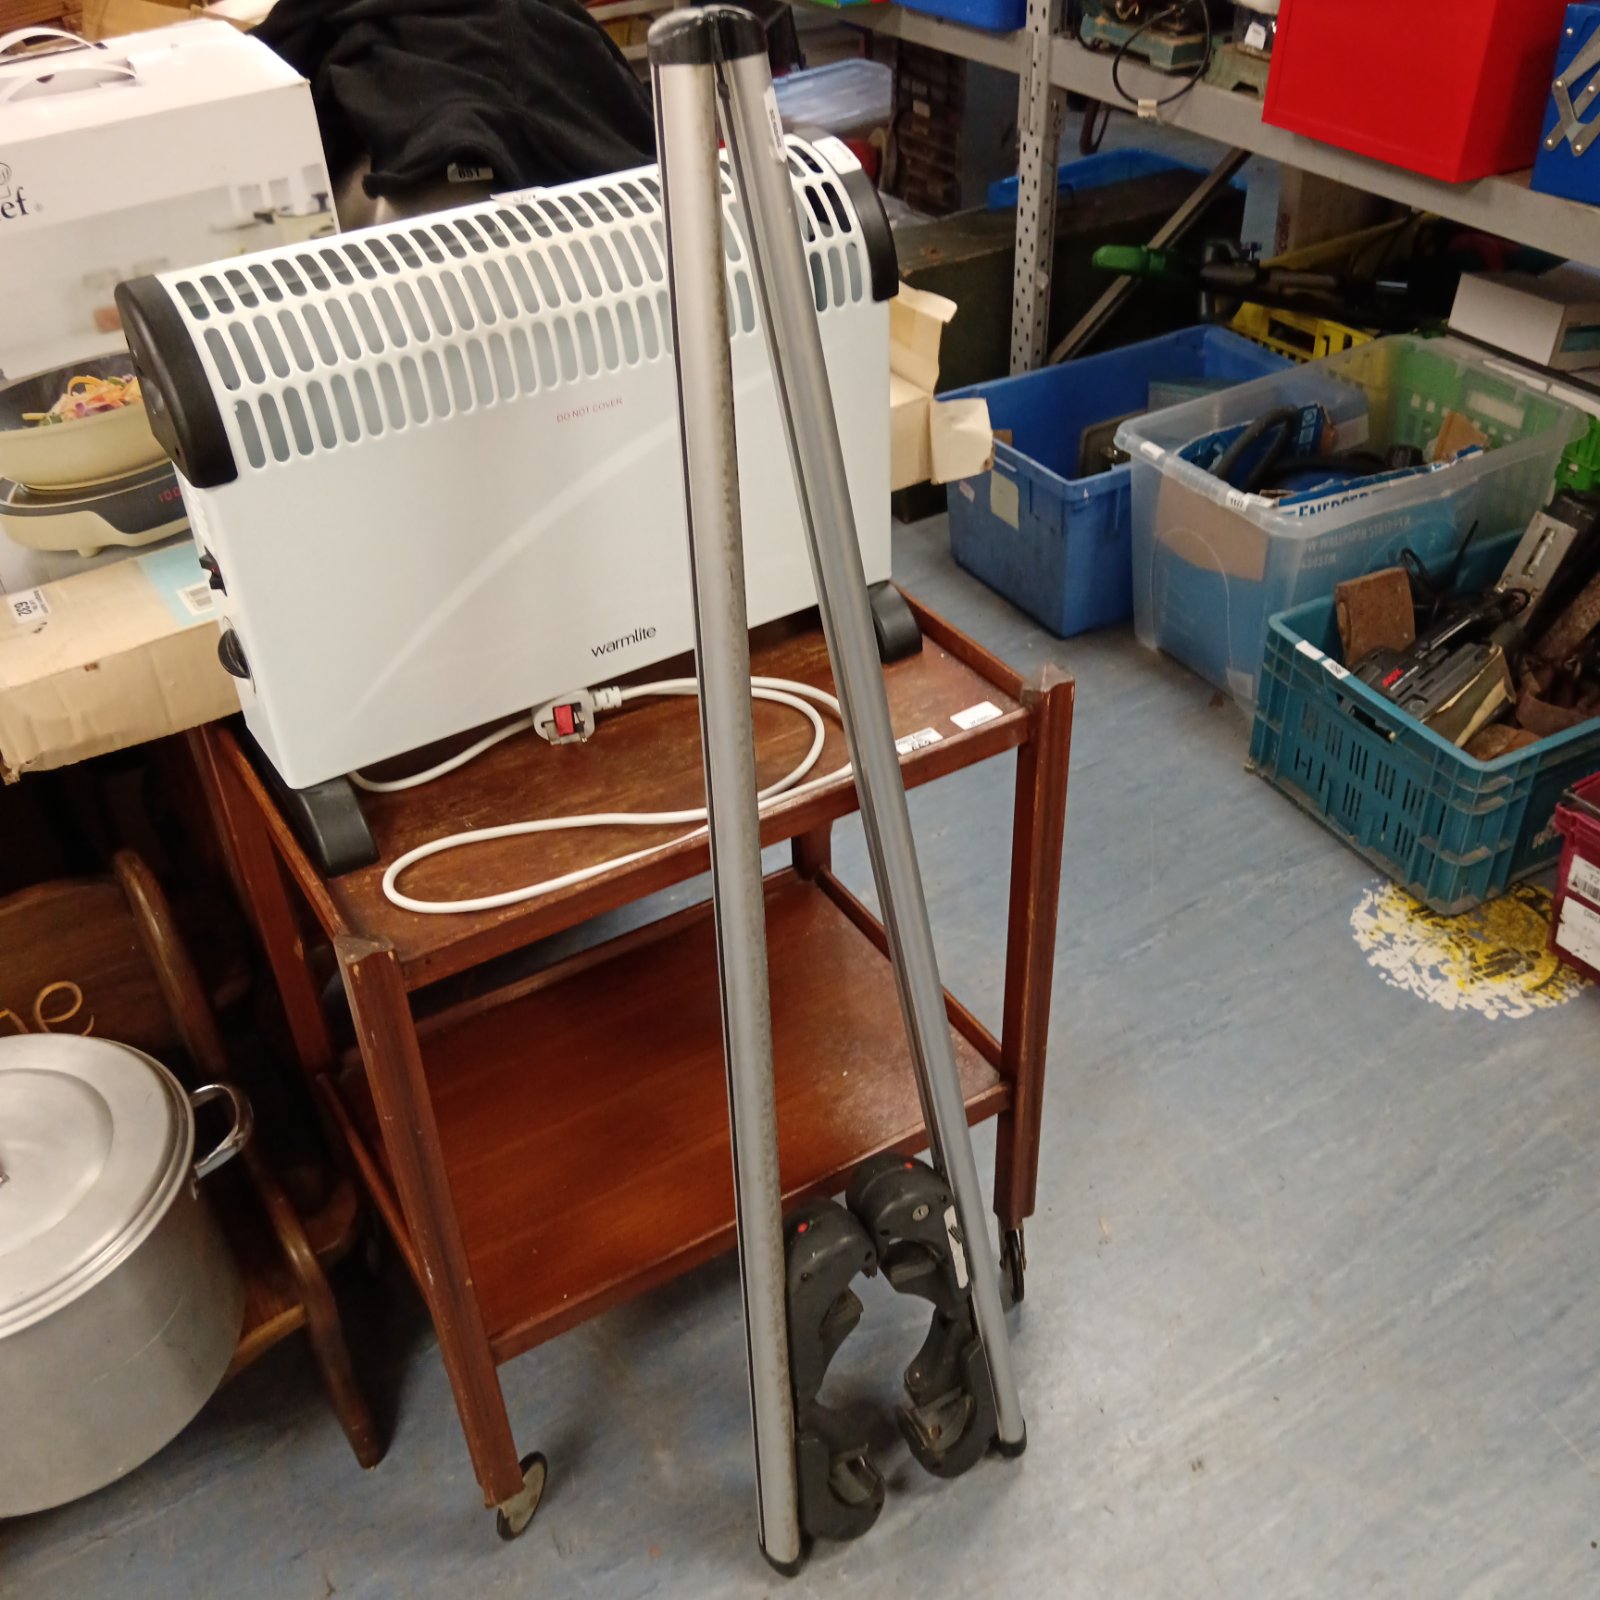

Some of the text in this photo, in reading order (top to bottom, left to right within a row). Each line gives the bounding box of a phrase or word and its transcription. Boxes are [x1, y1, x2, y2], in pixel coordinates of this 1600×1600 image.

[572, 405, 589, 418] NOT
[592, 397, 623, 413] COVER
[591, 626, 657, 657] warmlite
